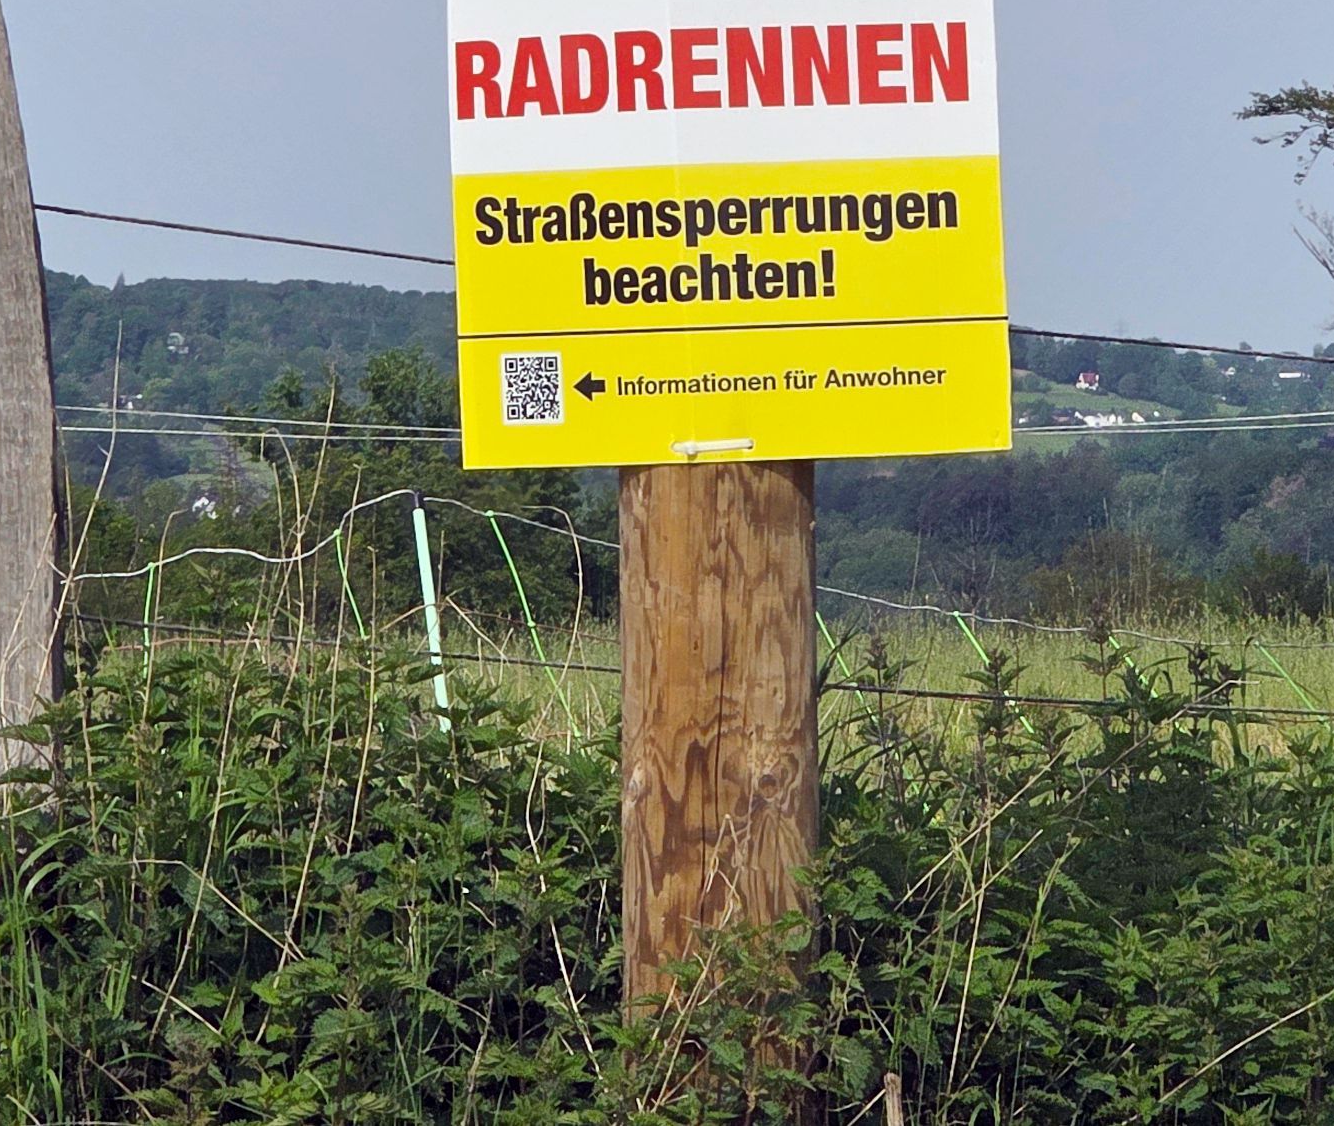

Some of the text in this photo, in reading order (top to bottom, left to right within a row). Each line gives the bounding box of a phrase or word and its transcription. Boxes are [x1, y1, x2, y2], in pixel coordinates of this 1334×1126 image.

[454, 22, 970, 120] RADRENNEN
[475, 190, 958, 248] Straßensperrungen
[583, 250, 835, 306] beachten!
[617, 366, 947, 396] Informationen für Anwohner
